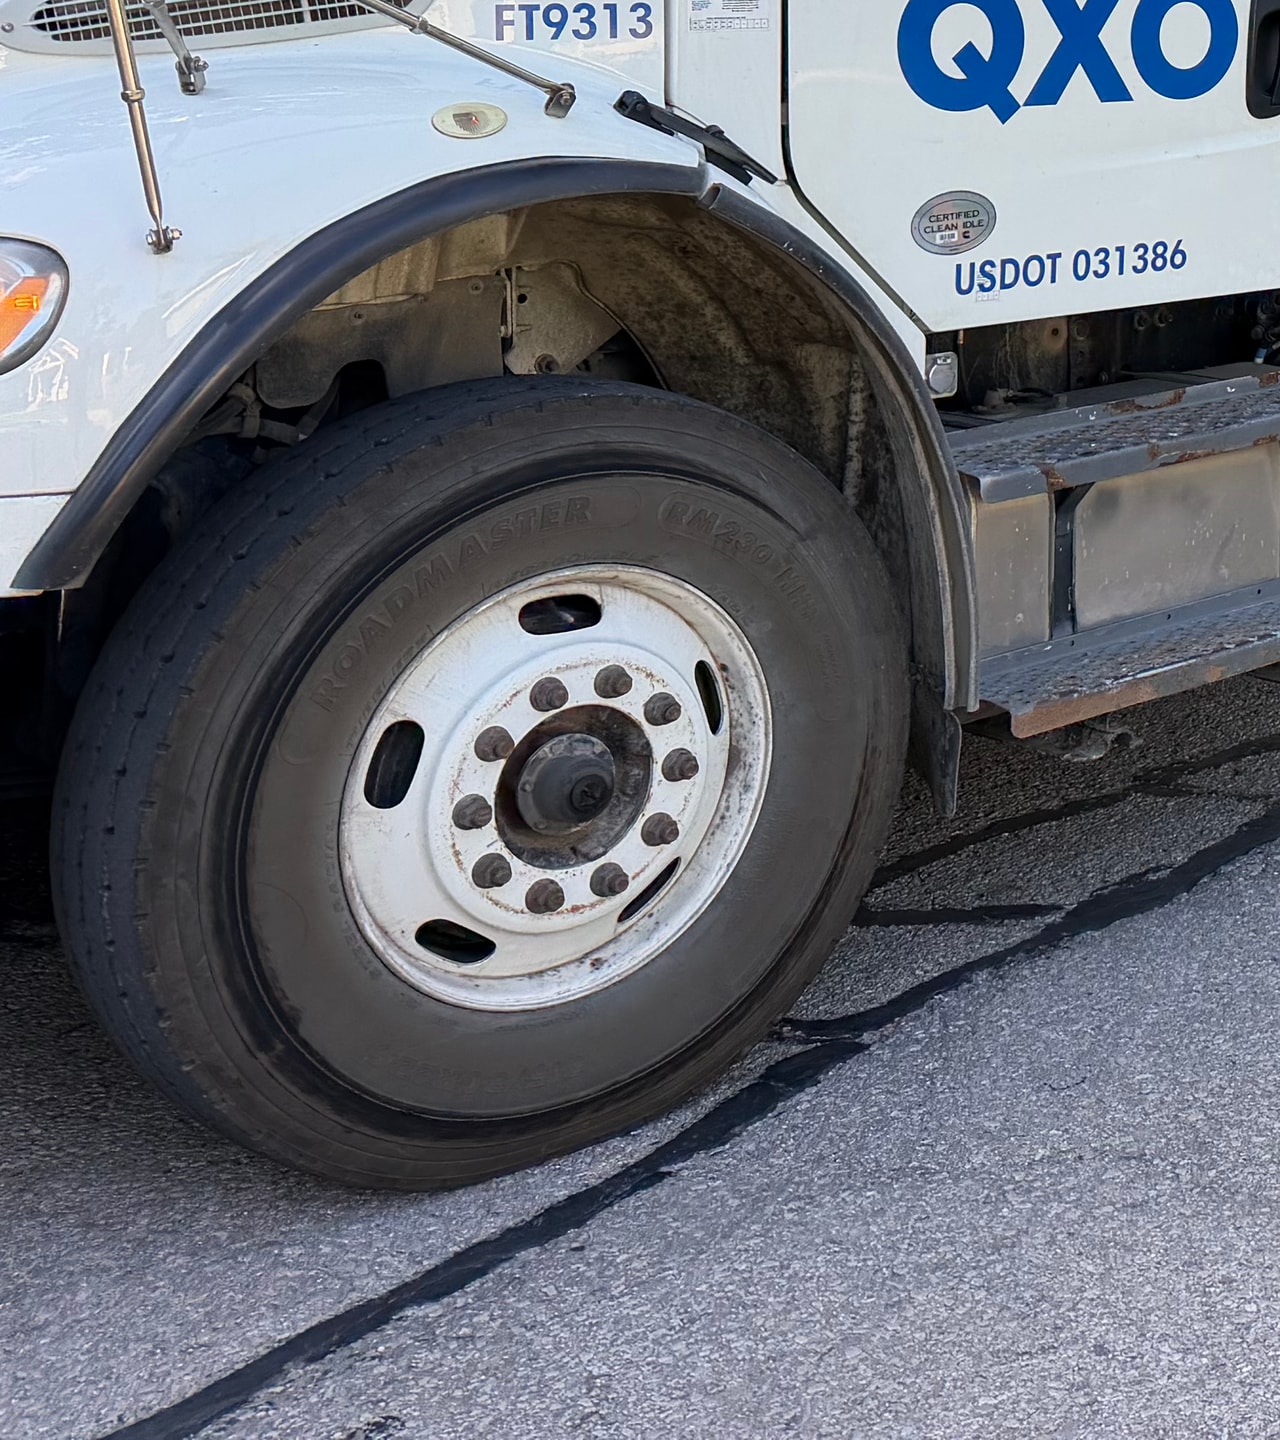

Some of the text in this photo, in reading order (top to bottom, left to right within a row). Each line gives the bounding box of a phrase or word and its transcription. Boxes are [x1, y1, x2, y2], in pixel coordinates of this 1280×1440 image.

[494, 2, 654, 42] FT9313
[924, 218, 985, 235] CLEAN IDLE
[928, 209, 980, 223] CERTIFIED
[955, 239, 1188, 295] USDOT 031386
[309, 495, 592, 713] ROADMASTER
